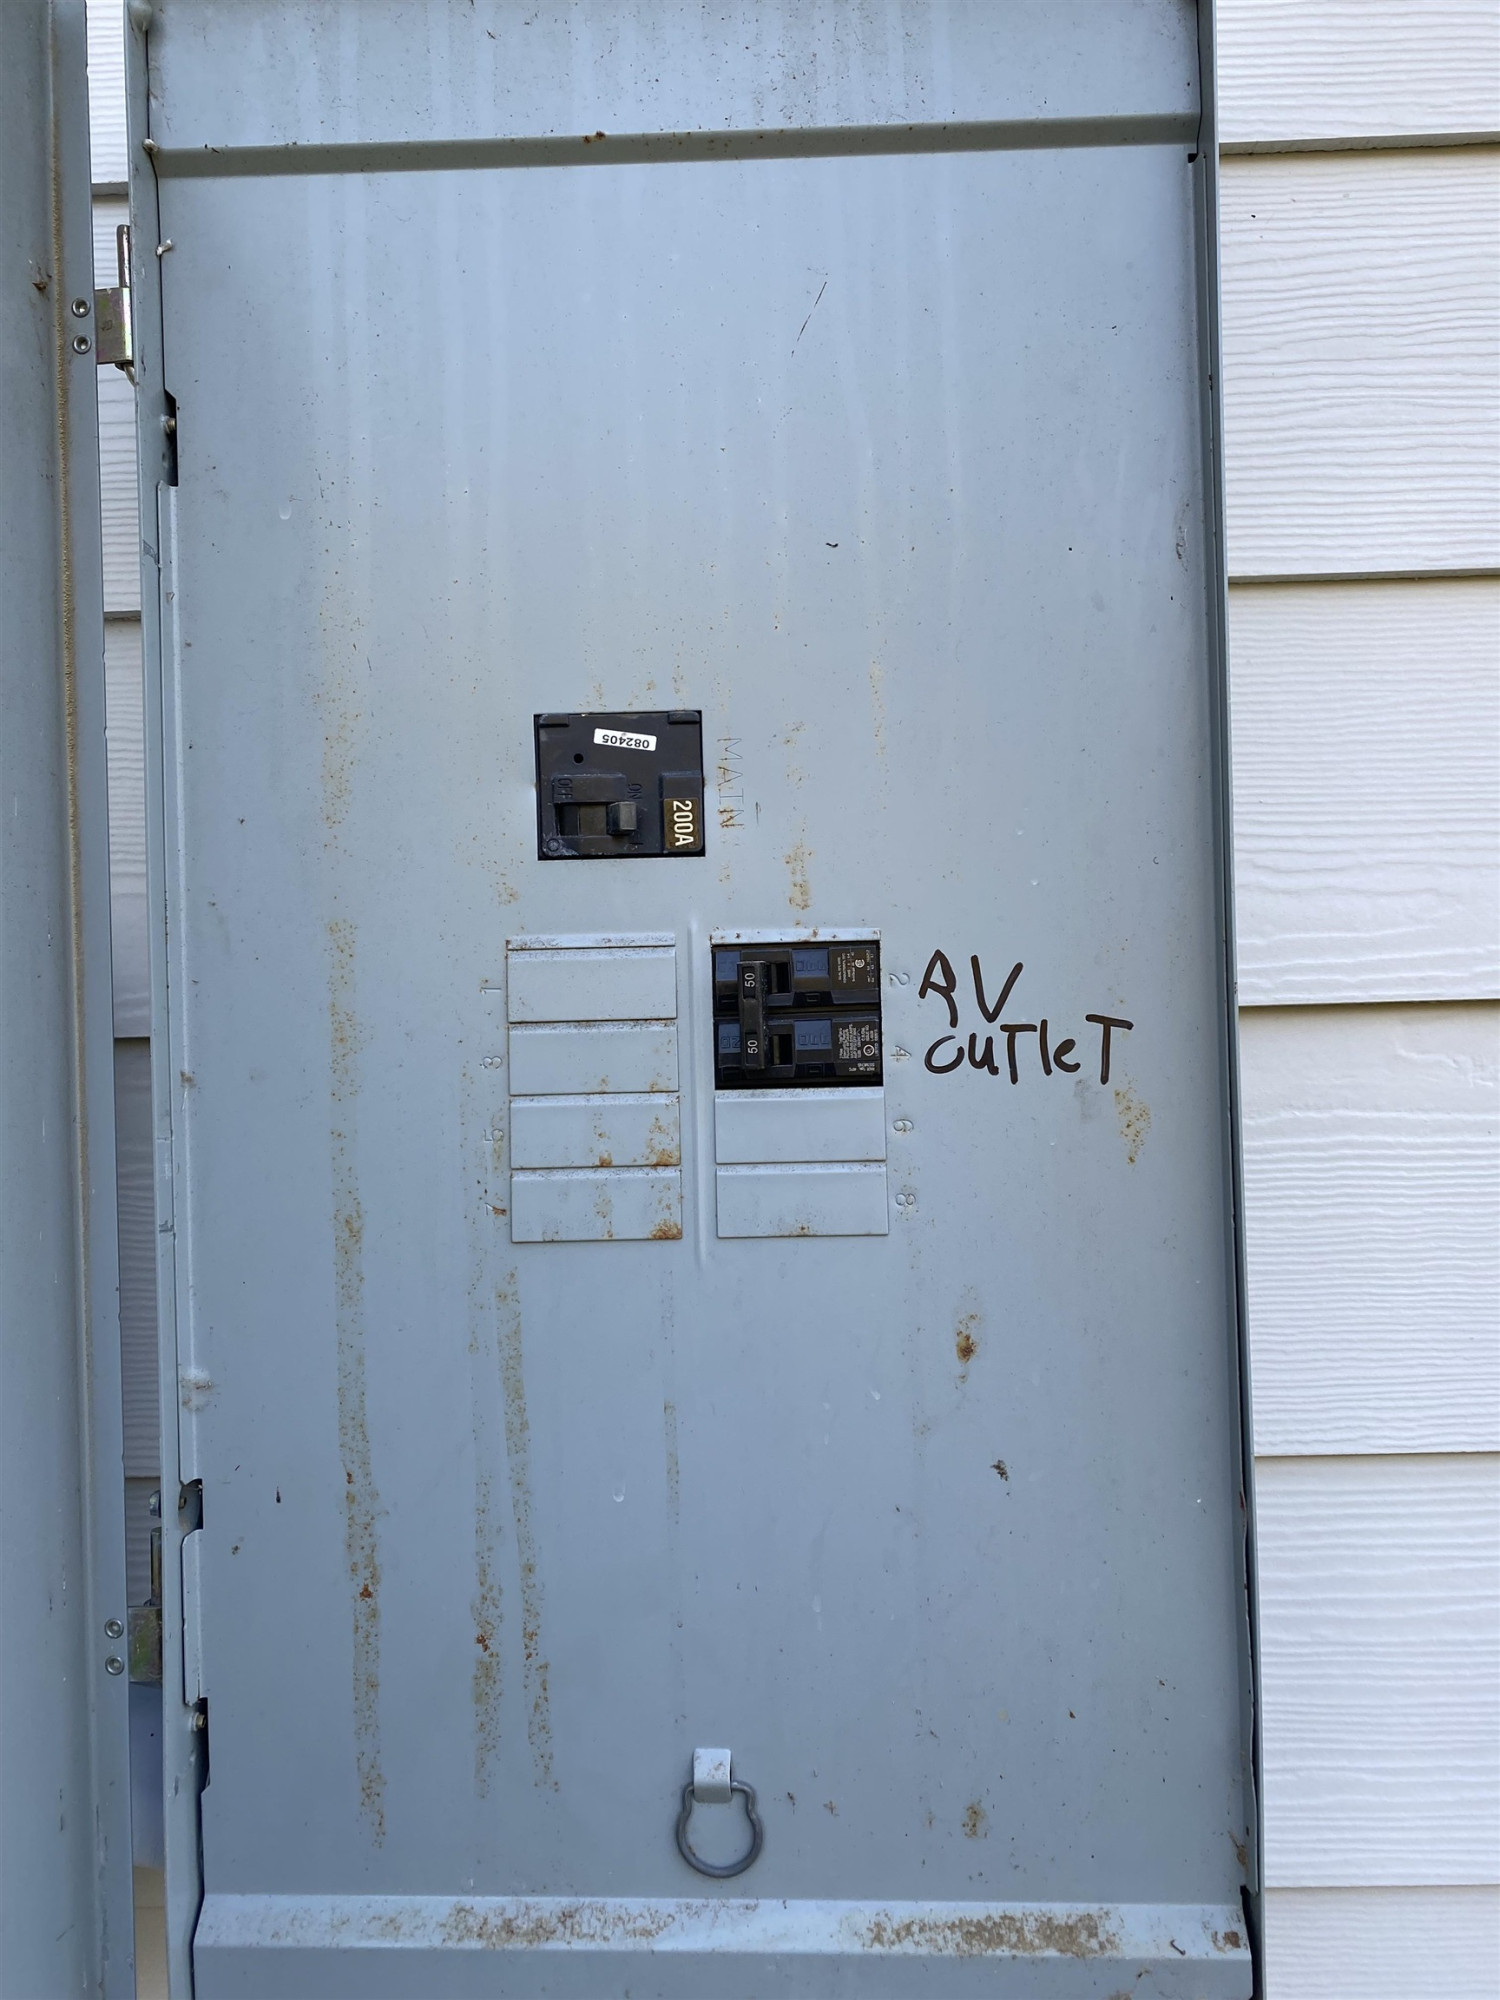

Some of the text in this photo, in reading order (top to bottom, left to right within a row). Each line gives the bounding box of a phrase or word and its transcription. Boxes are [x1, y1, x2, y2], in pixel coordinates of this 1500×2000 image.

[601, 734, 650, 749] 082405
[557, 777, 573, 799] OFF
[717, 737, 745, 830] MAIN
[672, 800, 694, 847] 200A
[744, 972, 756, 988] 50
[747, 1039, 759, 1054] 50
